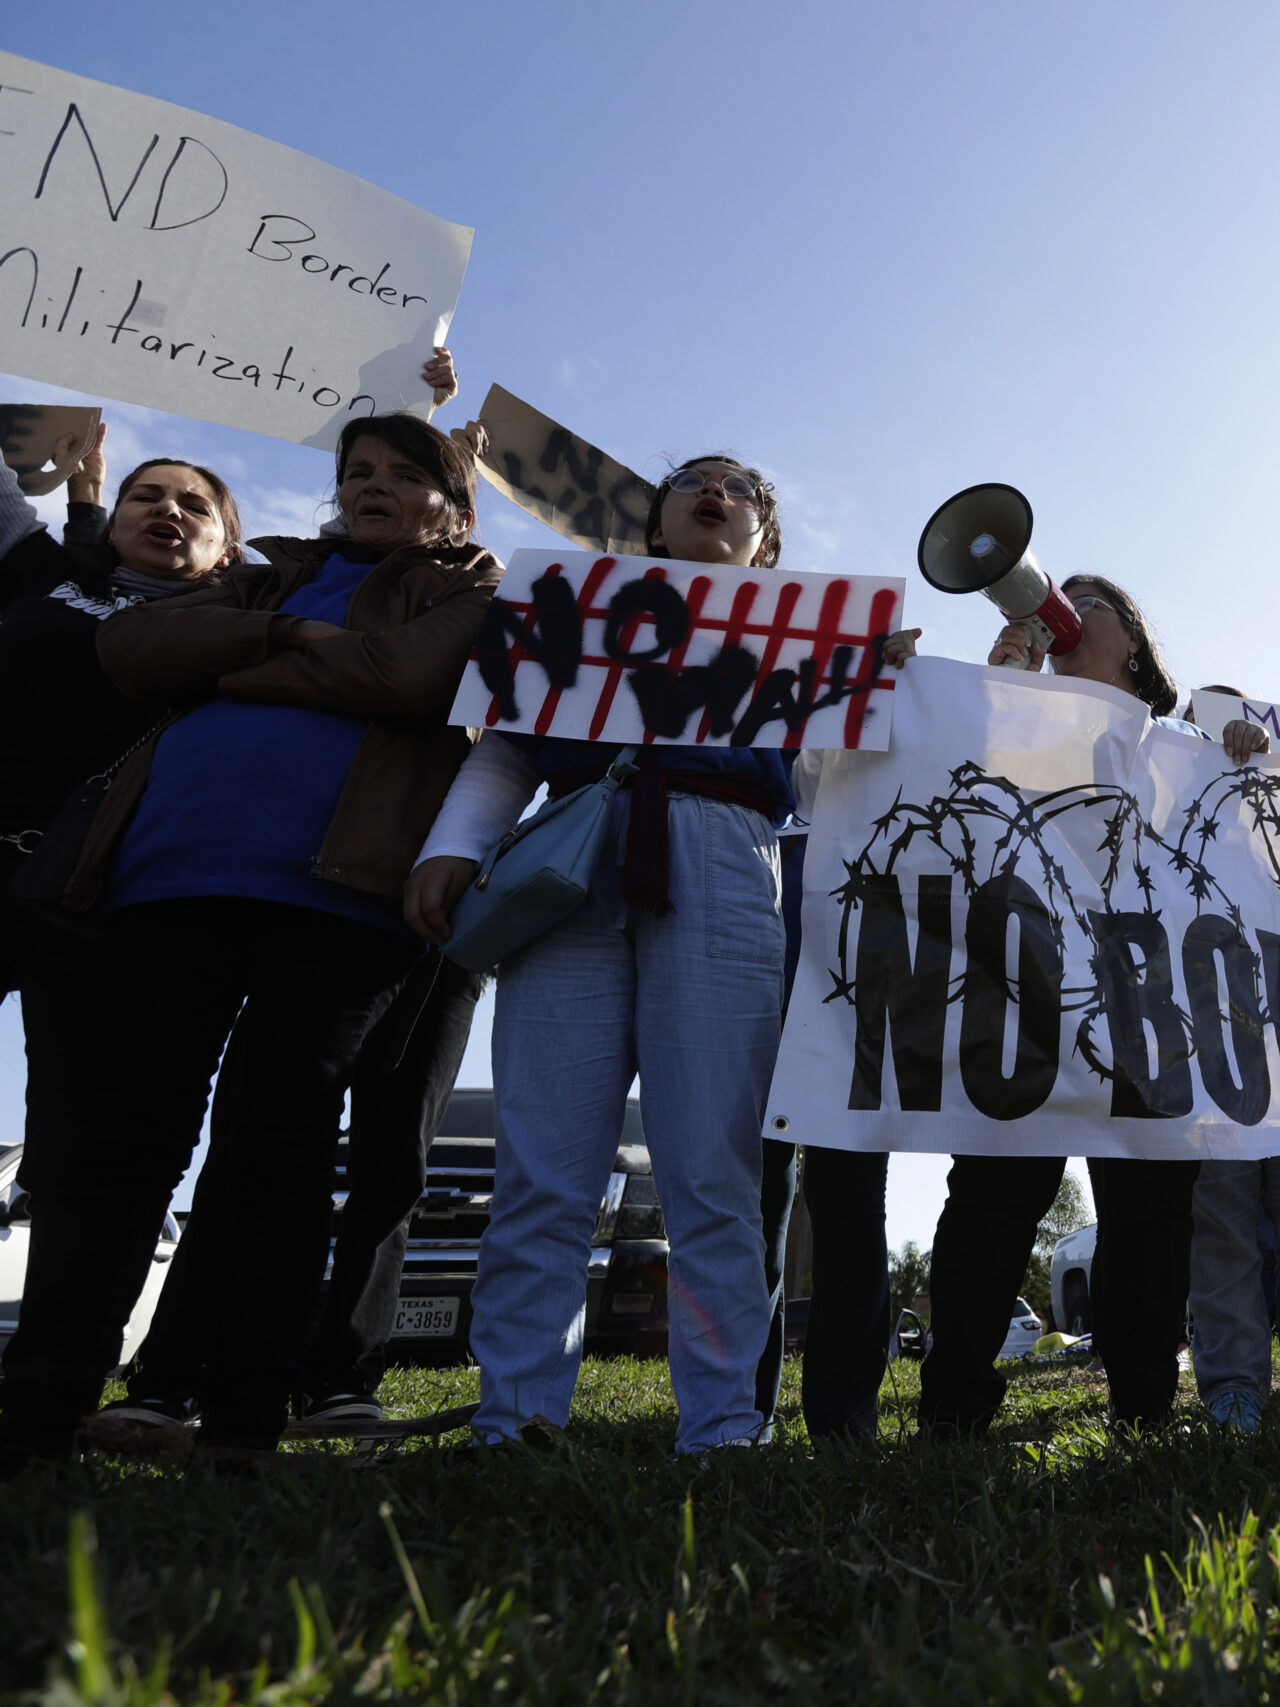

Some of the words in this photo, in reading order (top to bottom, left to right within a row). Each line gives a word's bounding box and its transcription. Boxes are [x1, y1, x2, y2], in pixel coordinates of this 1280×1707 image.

[247, 215, 427, 307] Border
[475, 576, 690, 722] NO
[847, 875, 1061, 1121] NO
